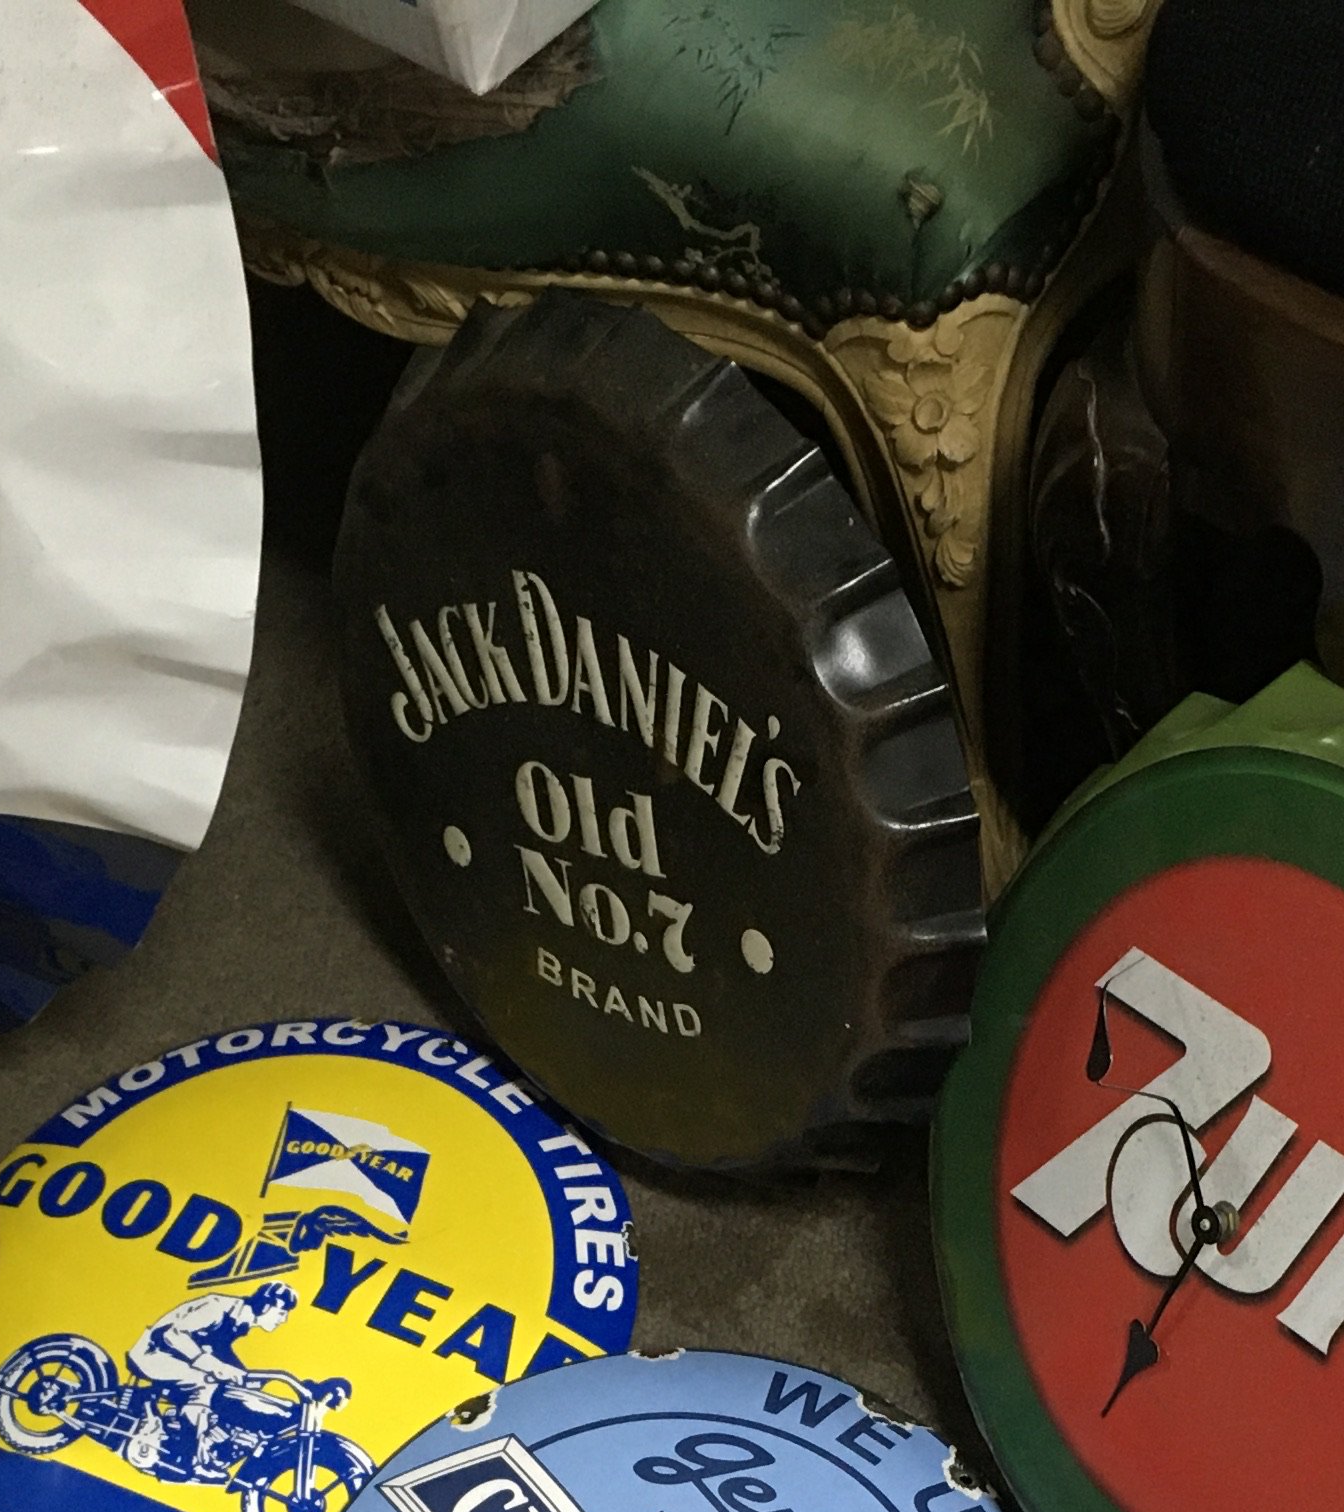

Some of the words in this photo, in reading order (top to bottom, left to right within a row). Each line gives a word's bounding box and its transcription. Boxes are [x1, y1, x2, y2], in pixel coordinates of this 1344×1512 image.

[373, 601, 528, 743] JACK
[511, 569, 802, 855] DANIEL'S
[514, 760, 668, 879] Old
[537, 947, 701, 1038] BRAND
[59, 1020, 536, 1130] MOTORCYCLE
[537, 1125, 626, 1314] TIRES
[763, 1371, 916, 1467] WE
